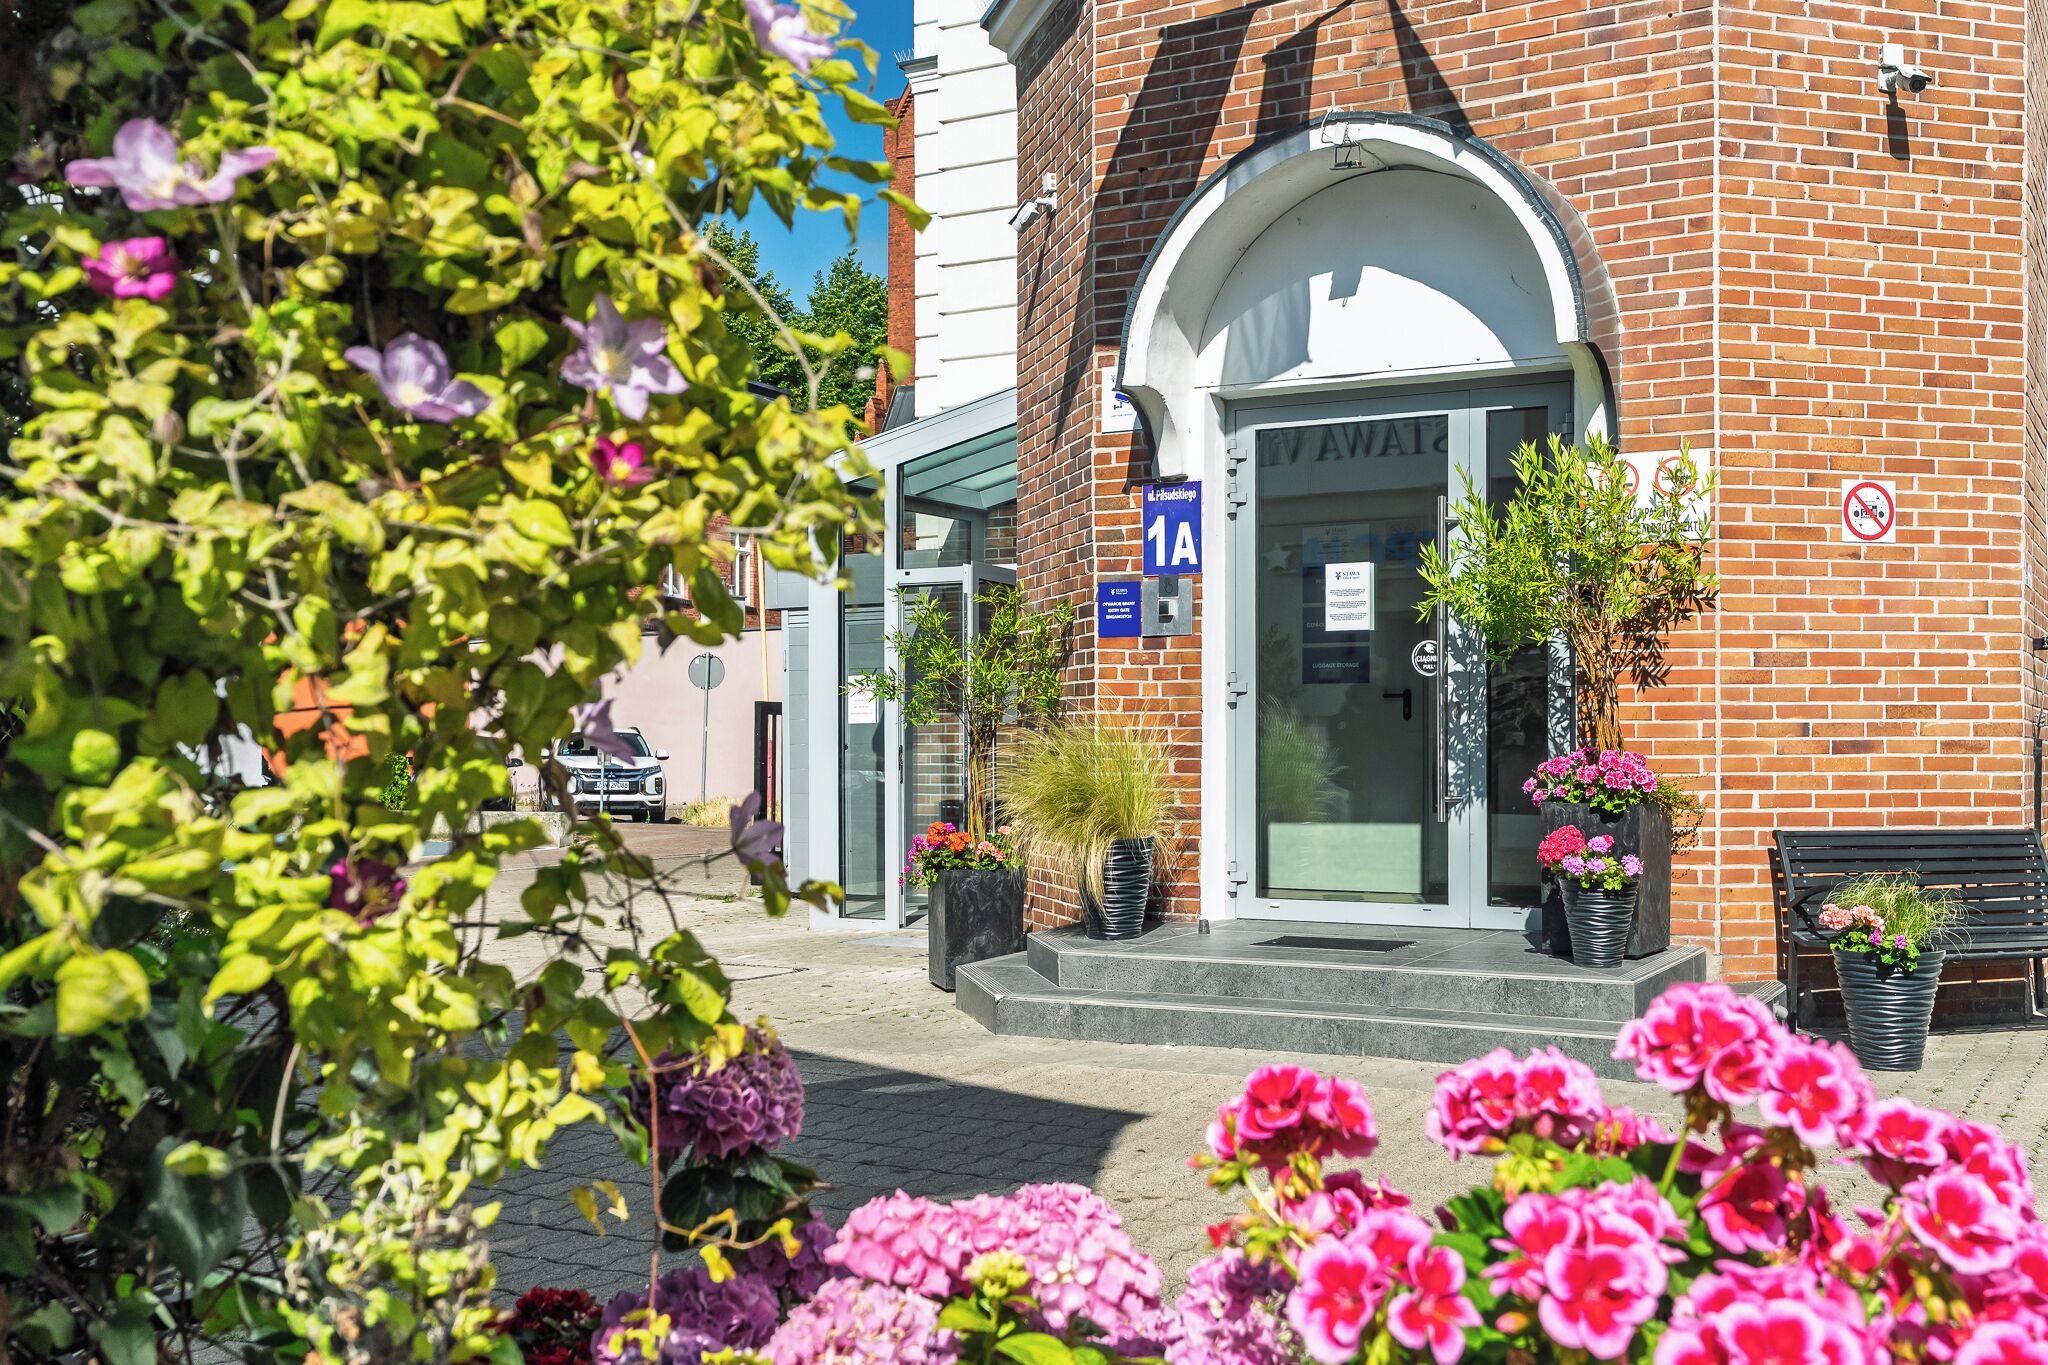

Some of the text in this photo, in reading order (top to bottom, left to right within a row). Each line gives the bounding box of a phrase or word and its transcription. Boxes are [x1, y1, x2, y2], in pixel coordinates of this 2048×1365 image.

[1147, 487, 1197, 503] ul. Piłsudskiego
[1147, 514, 1198, 567] 1A
